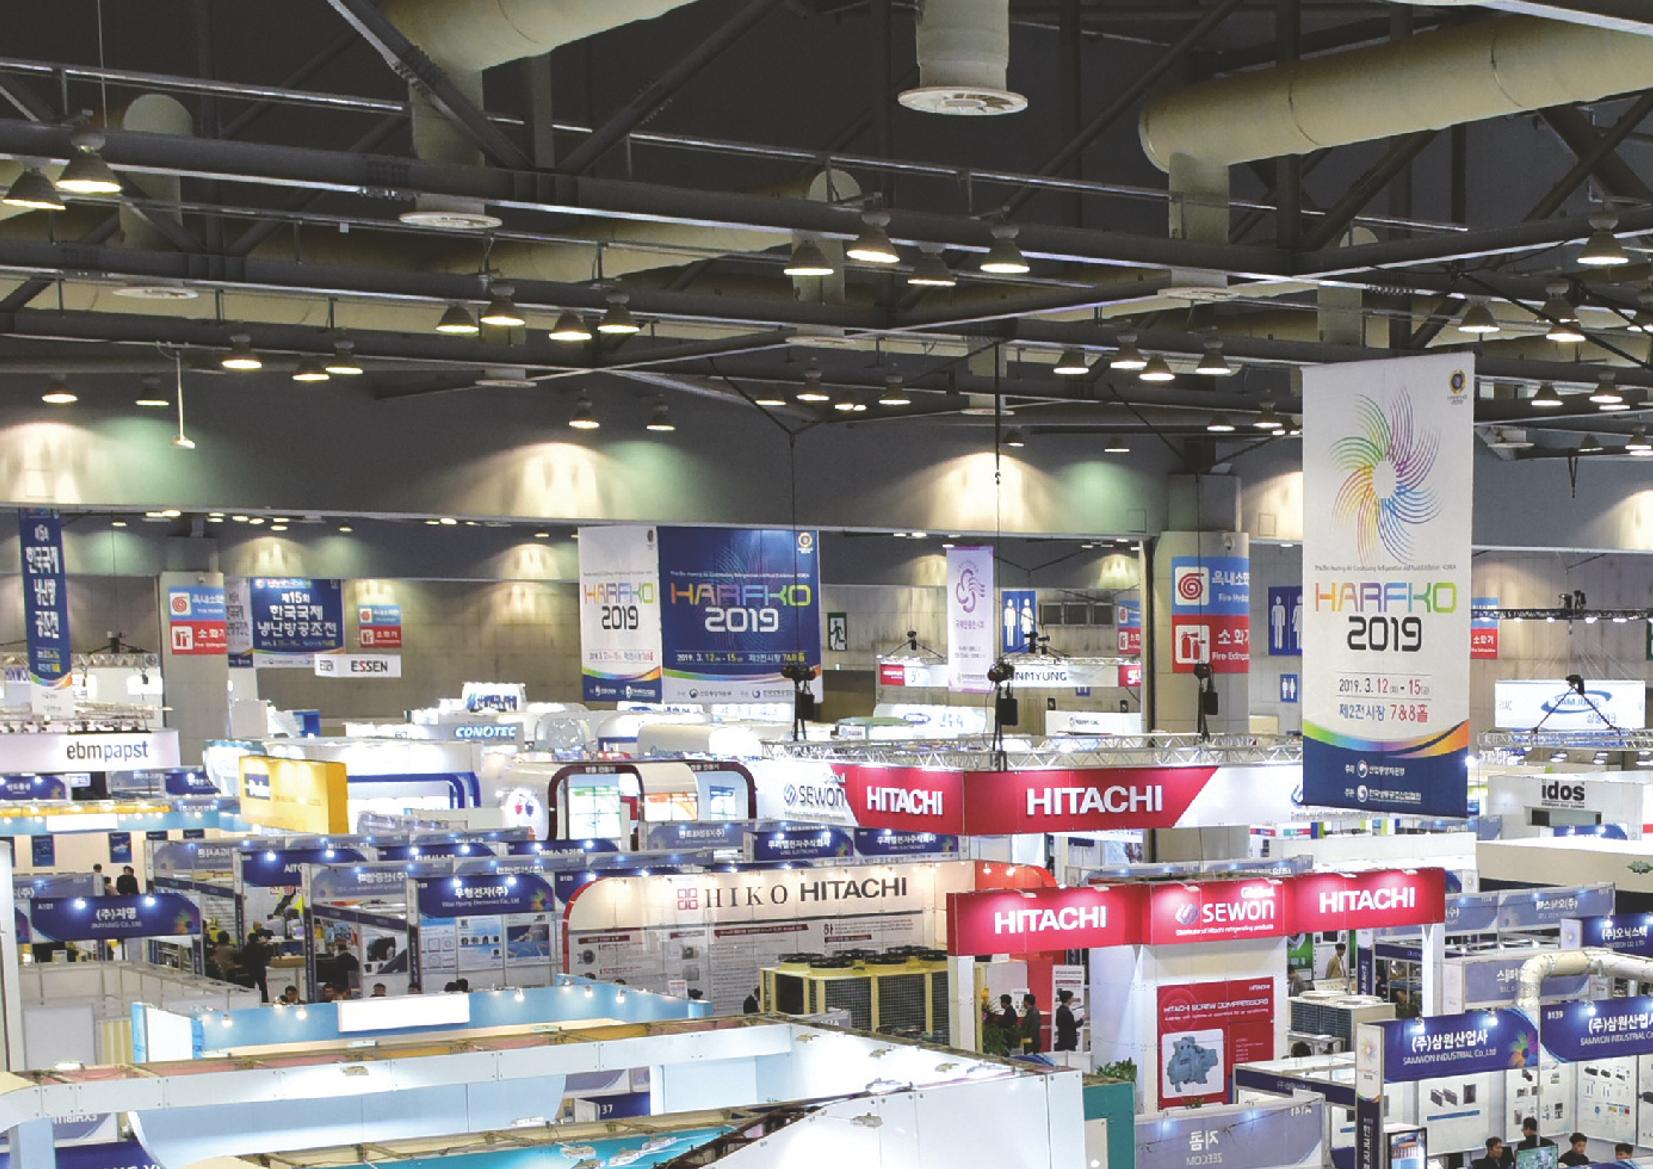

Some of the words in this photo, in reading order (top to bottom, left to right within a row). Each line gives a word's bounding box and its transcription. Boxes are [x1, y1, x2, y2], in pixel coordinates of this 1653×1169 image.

[585, 582, 653, 604] HARFKO
[671, 583, 811, 606] HARFKO
[1315, 582, 1457, 613] HARFKO
[269, 605, 323, 621] 한국국제
[602, 606, 639, 630] 2019
[705, 607, 778, 632] 2019
[257, 621, 337, 637] 냉난방공조전
[1347, 616, 1422, 651] 2019
[351, 661, 388, 672] ESSEN
[1339, 703, 1385, 721] 제2전시장
[456, 726, 517, 738] CONOTEC
[67, 741, 149, 762] ebmpapst
[866, 786, 944, 816] HITACHI
[1026, 784, 1164, 816] HITACHI
[1542, 781, 1585, 801] idos
[800, 878, 907, 902] HITACHI
[1319, 887, 1416, 913] HITACHI
[994, 905, 1107, 935] HITACHI
[1412, 1029, 1488, 1053] (주)삼원산업사
